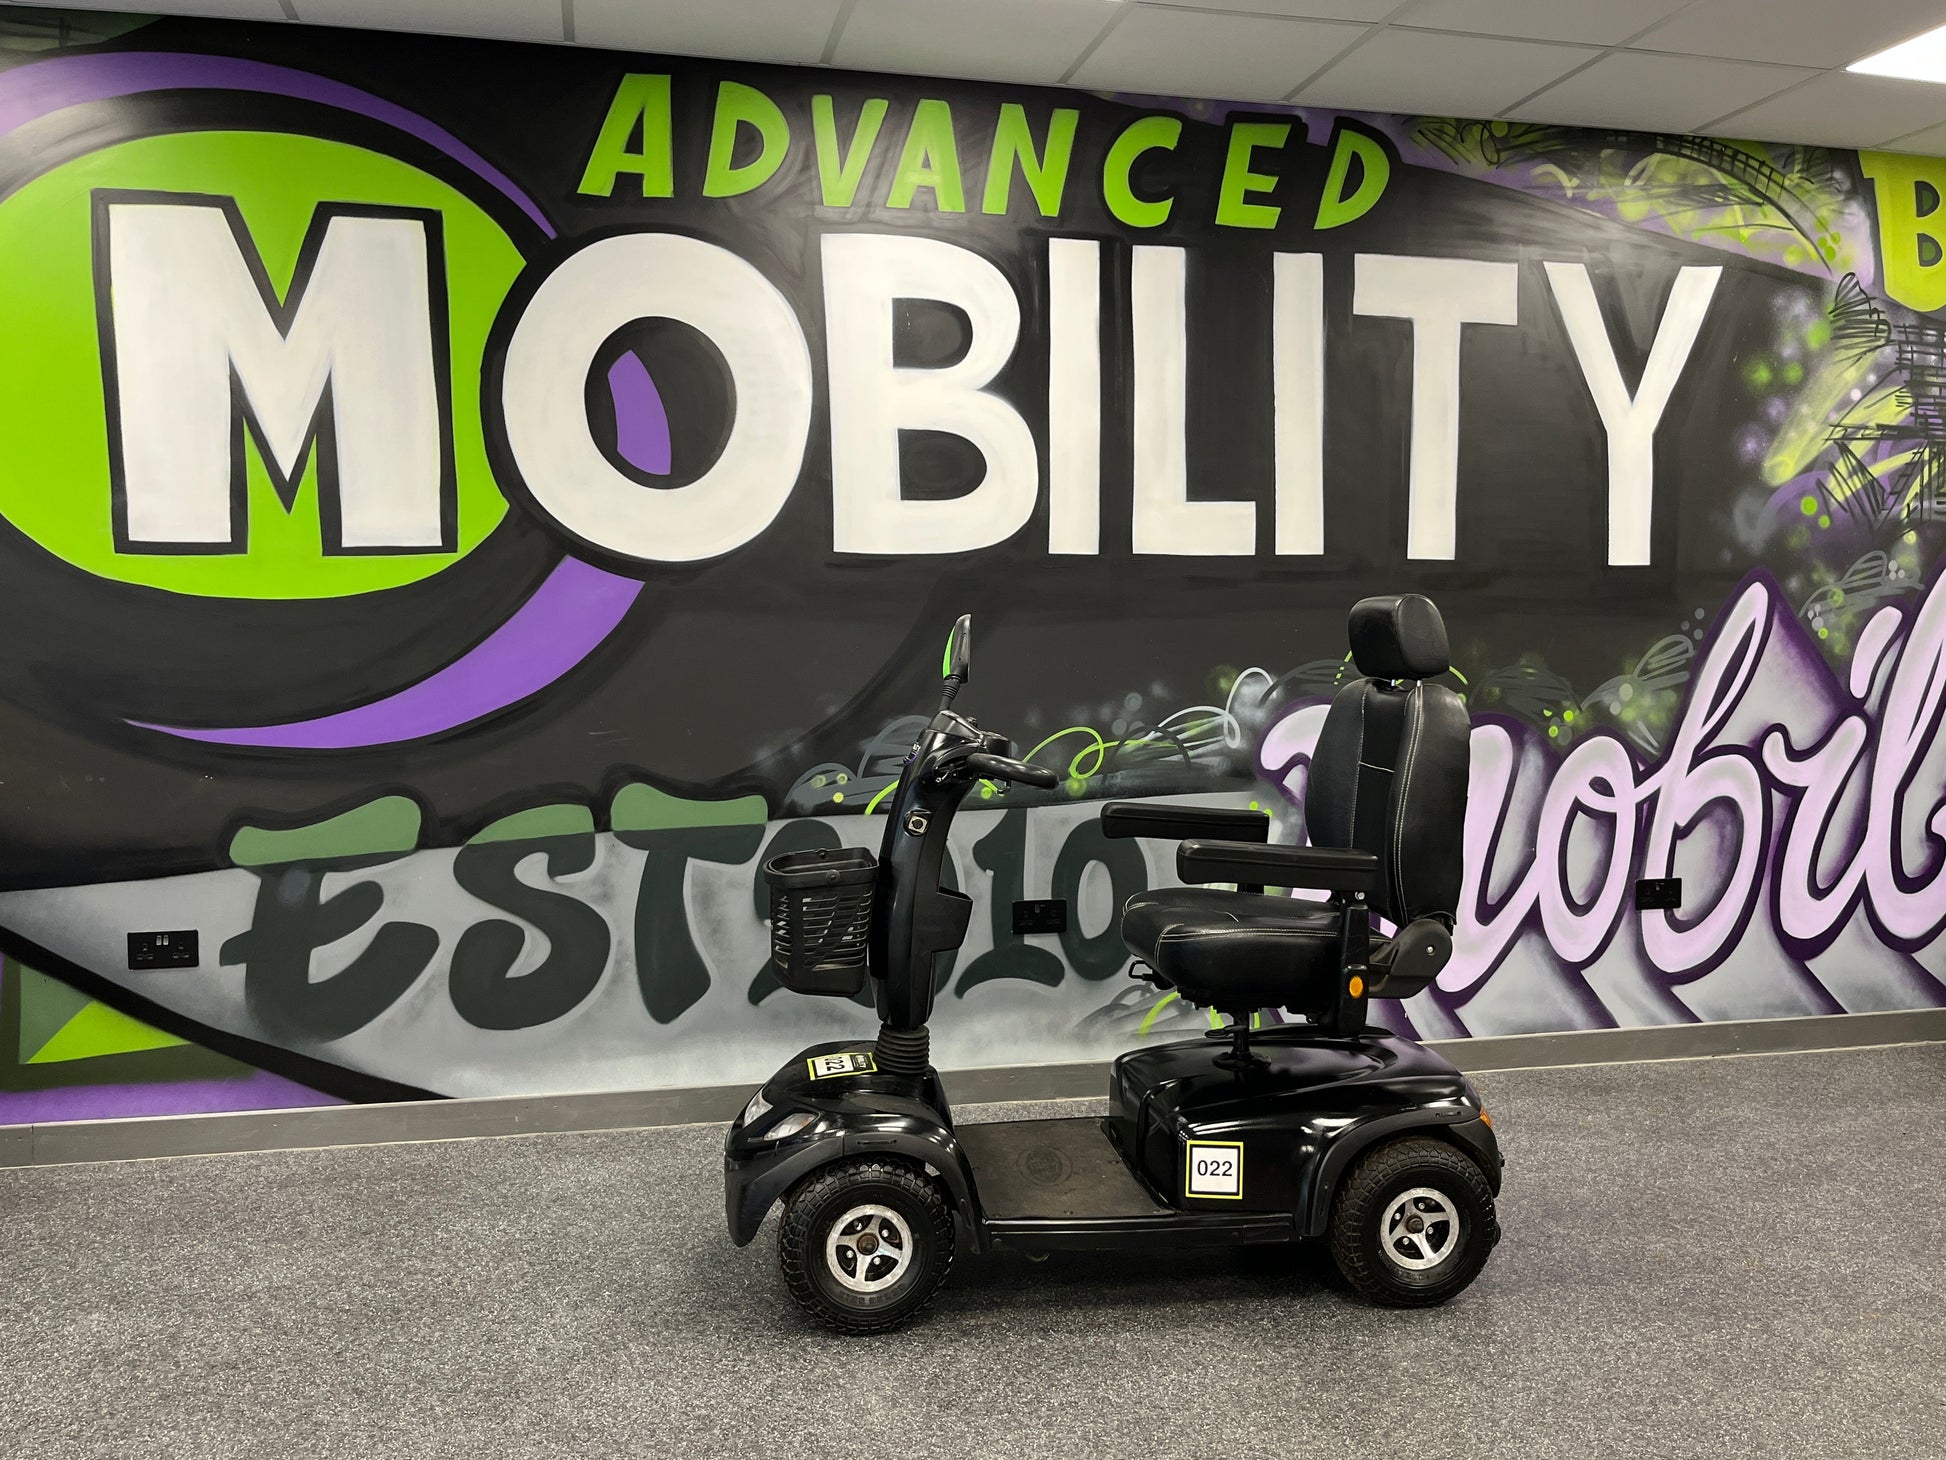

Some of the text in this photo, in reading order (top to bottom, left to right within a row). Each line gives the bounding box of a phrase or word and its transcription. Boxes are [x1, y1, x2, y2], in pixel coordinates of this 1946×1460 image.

[578, 73, 1391, 231] ADVANCED
[108, 203, 1723, 567] MOBILITY
[219, 781, 768, 1043] EST
[1197, 1160, 1233, 1177] 022
